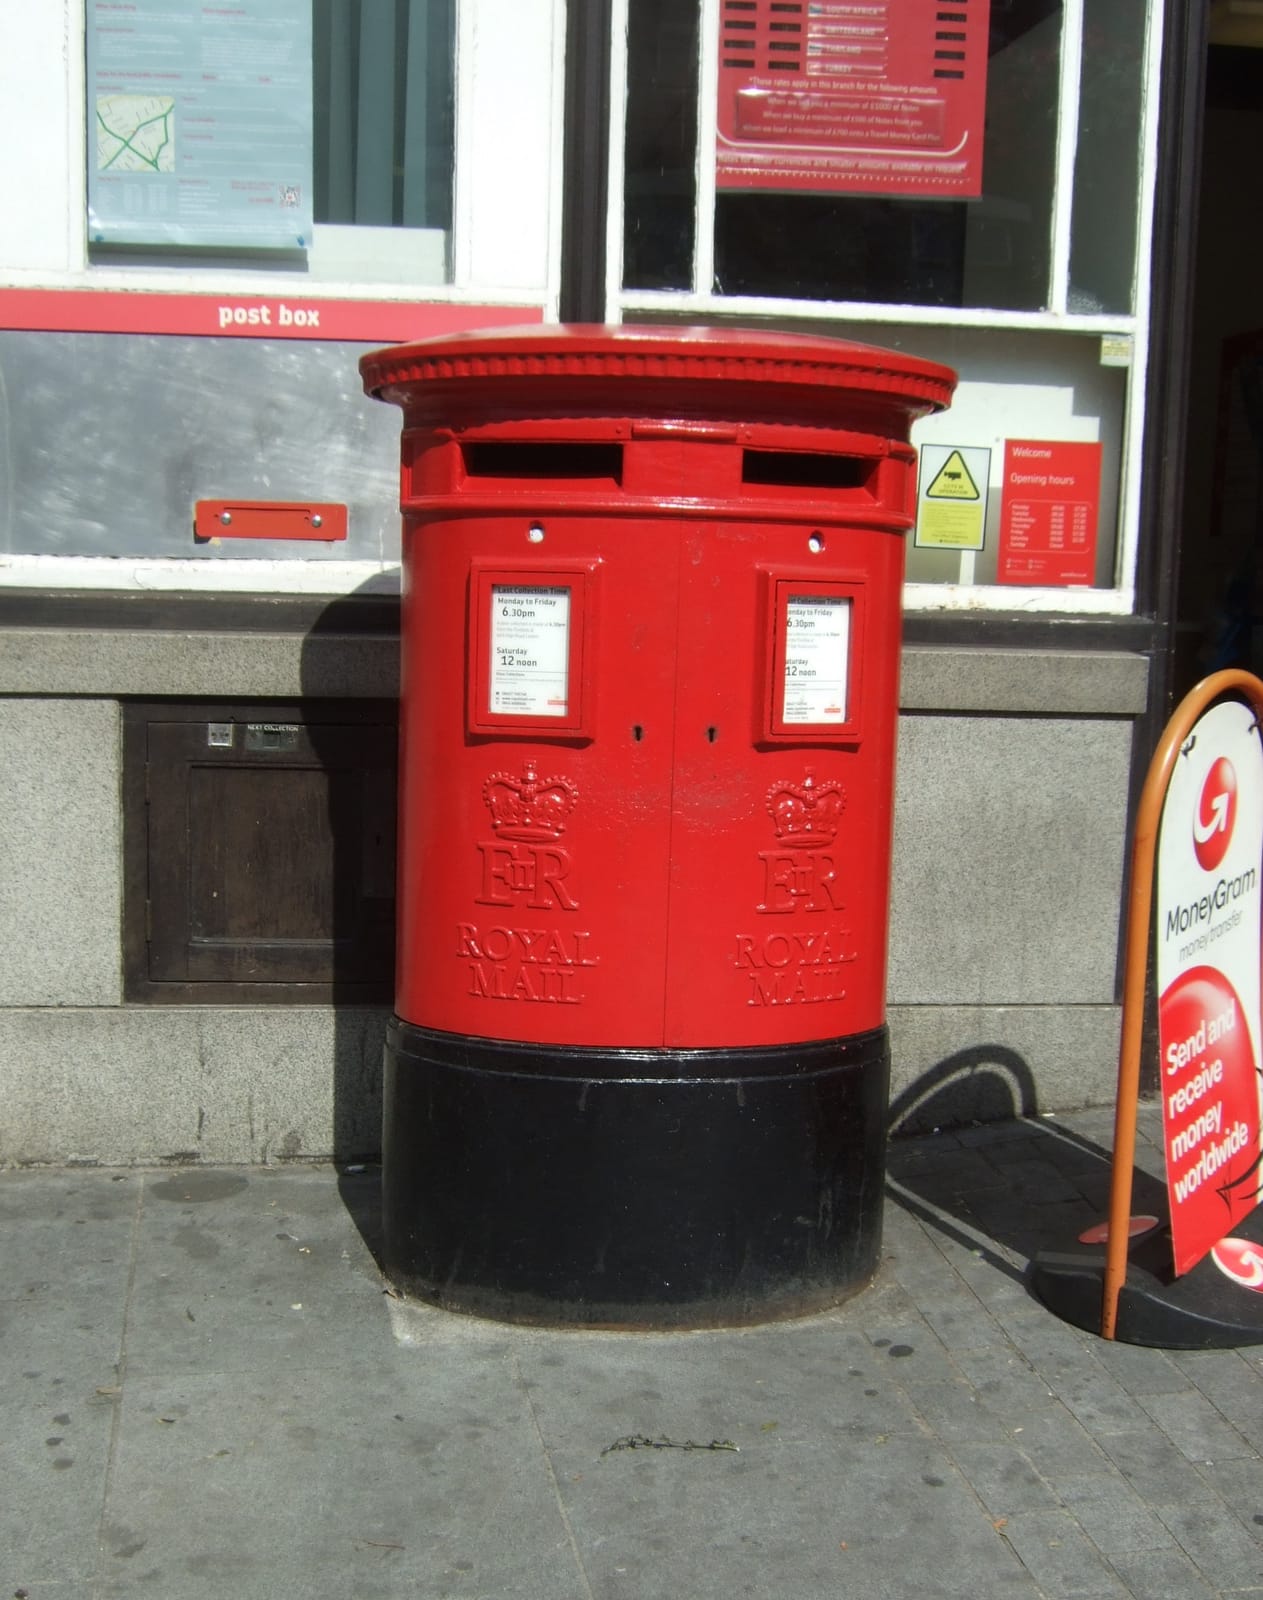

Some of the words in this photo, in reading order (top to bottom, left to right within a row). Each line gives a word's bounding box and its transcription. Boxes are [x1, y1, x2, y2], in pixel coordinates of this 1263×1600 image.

[792, 80, 809, 89] apply
[819, 80, 831, 89] this
[856, 81, 866, 90] for
[867, 82, 878, 91] the
[880, 83, 908, 94] following
[218, 305, 271, 328] post
[279, 304, 320, 327] box
[1012, 447, 1051, 458] Welcome
[1010, 472, 1047, 486] Opening
[1048, 474, 1075, 485] hours
[498, 597, 524, 606] Monday
[534, 598, 556, 607] Friday
[502, 607, 535, 618] 6.30pm
[787, 608, 806, 617] onday
[814, 608, 833, 617] Friday
[786, 617, 815, 629] 6.30pm
[496, 647, 527, 656] Saturday
[501, 655, 514, 666] 12
[516, 659, 537, 667] noon
[785, 658, 808, 666] aturday
[786, 666, 798, 676] 12
[1166, 868, 1256, 942] MoneyGram
[456, 922, 601, 967] ROYAL
[1178, 935, 1209, 963] money
[1208, 909, 1244, 942] transfer
[734, 929, 858, 969] ROYAL
[468, 963, 586, 1005] MAIL
[747, 967, 846, 1007] MAIL
[1166, 1019, 1206, 1076] Send
[1207, 997, 1236, 1045] and
[1168, 1058, 1223, 1120] receive
[1171, 1100, 1223, 1163] money
[1174, 1120, 1249, 1204] worldwide
